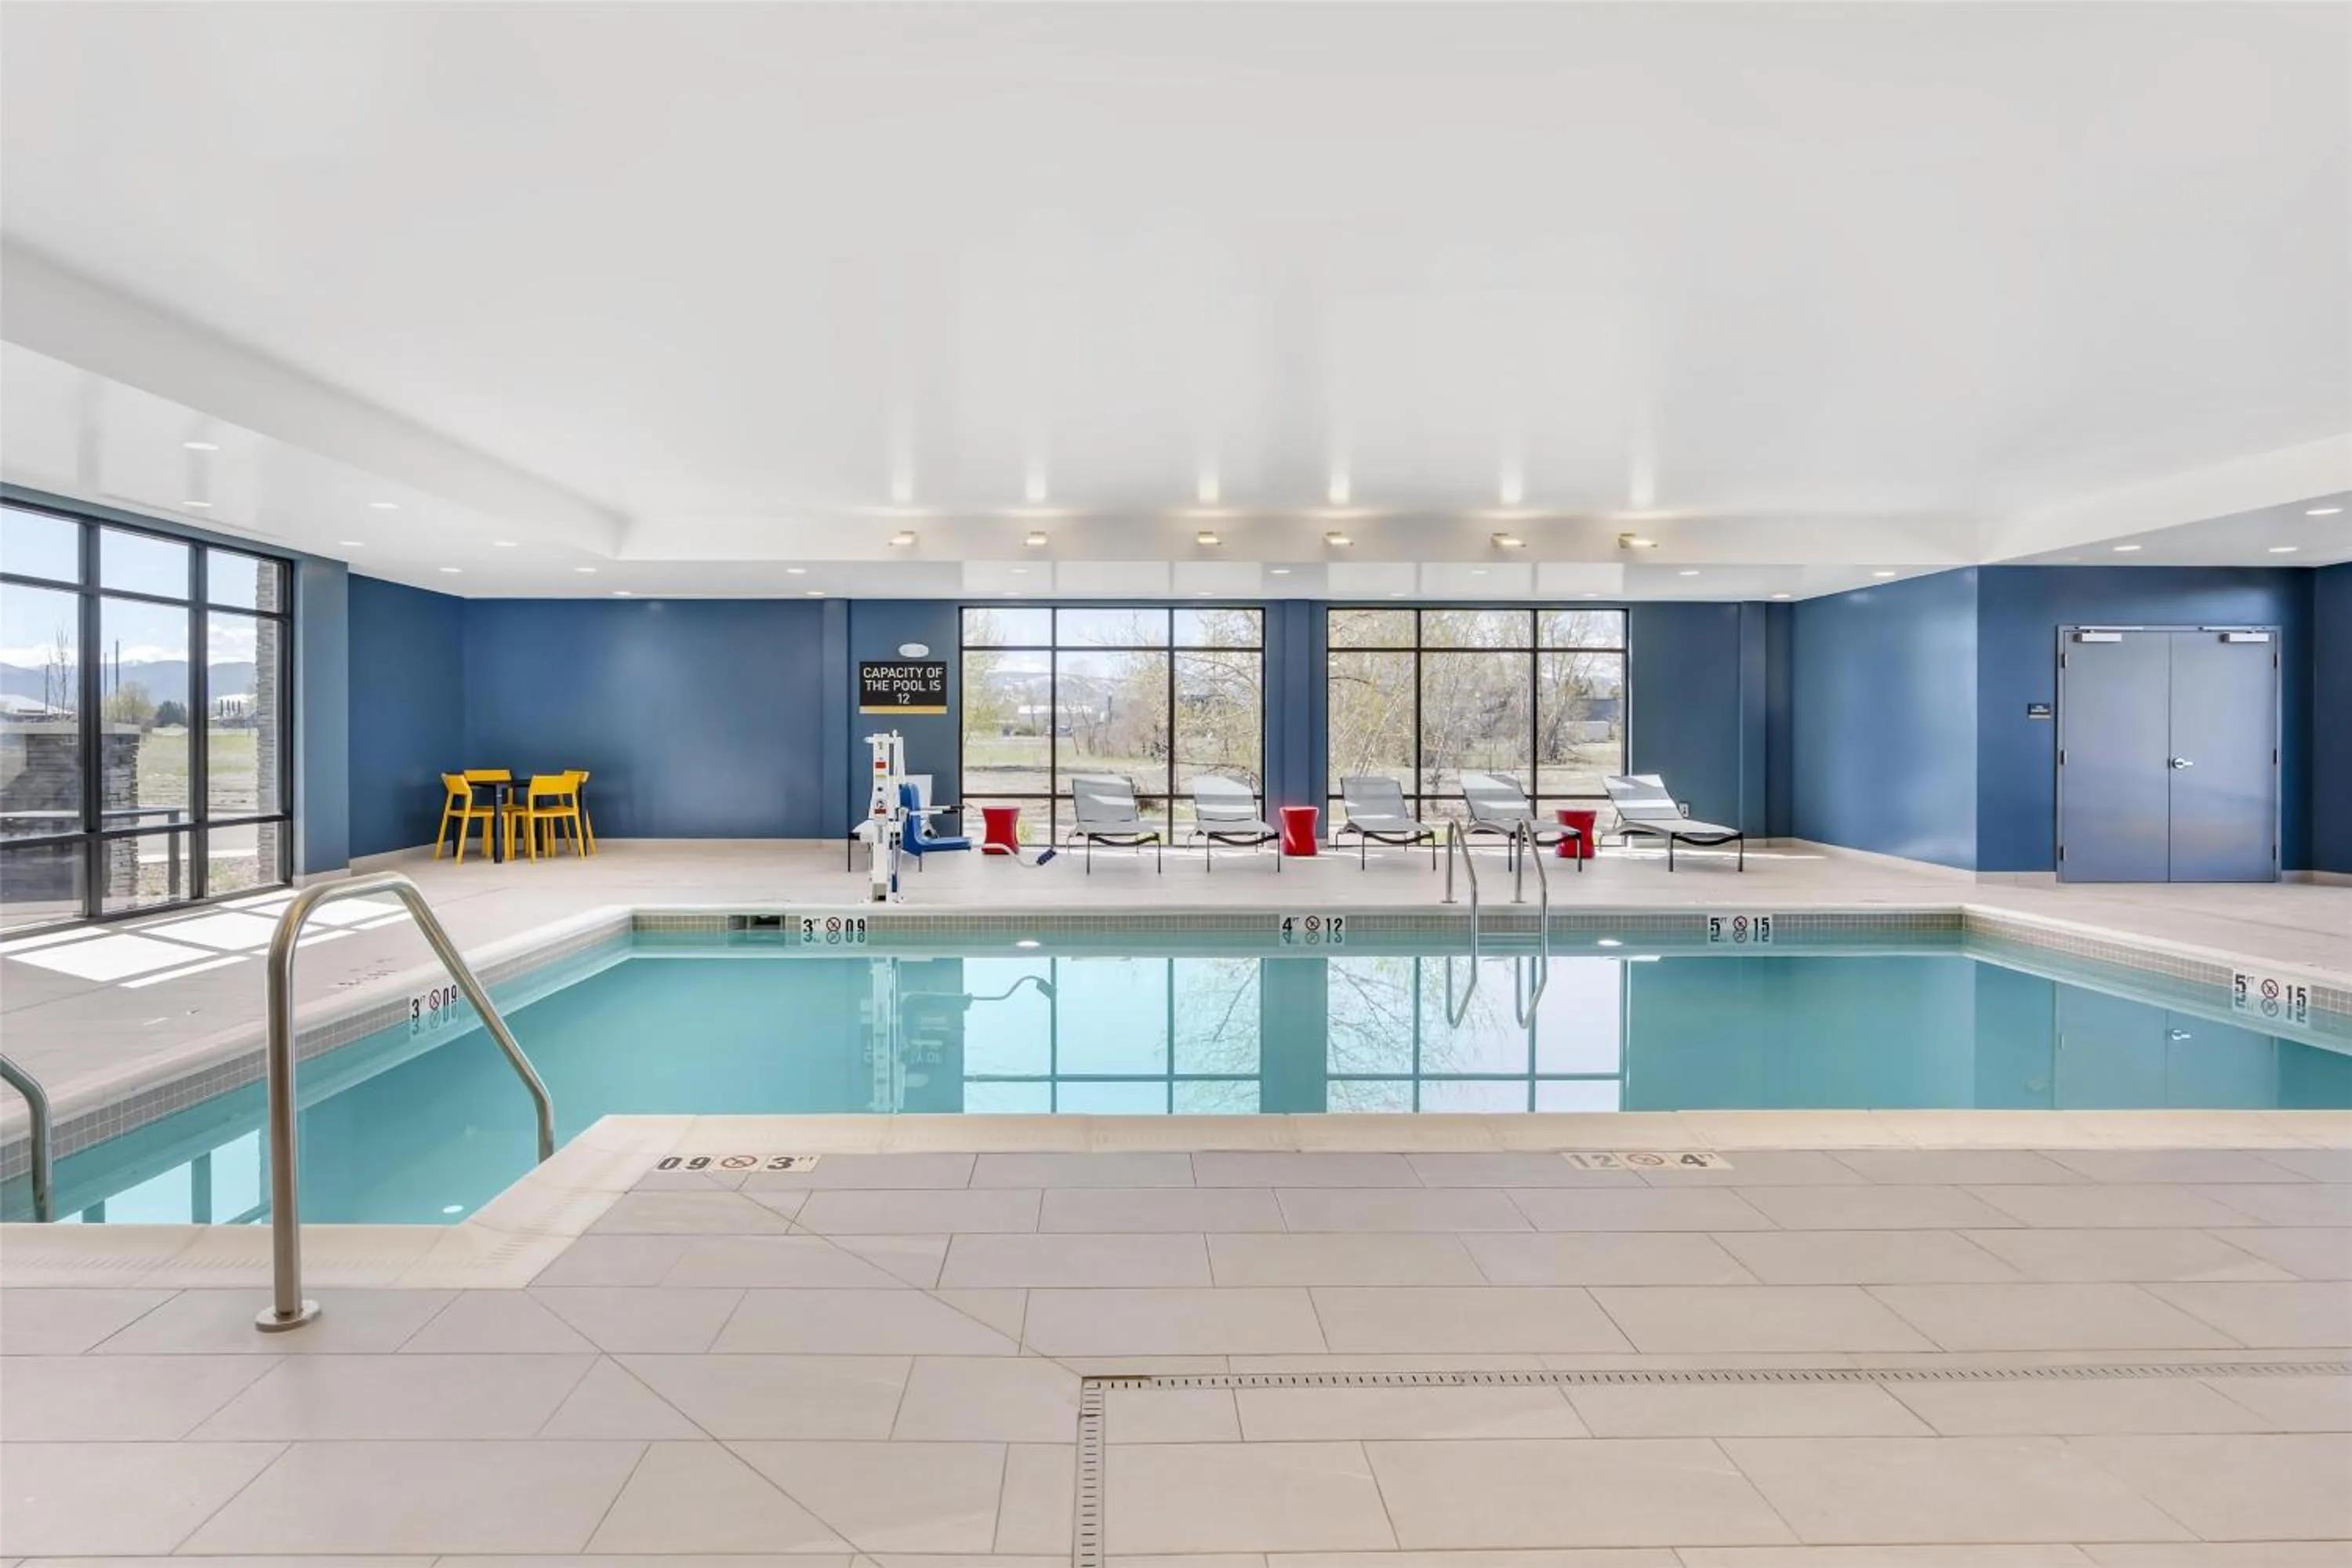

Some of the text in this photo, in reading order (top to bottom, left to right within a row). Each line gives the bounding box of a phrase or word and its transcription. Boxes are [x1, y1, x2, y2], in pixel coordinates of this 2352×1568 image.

[863, 667, 943, 678] CAPACITY OF
[865, 680, 942, 691] THE POOL IS
[897, 693, 910, 704] 12
